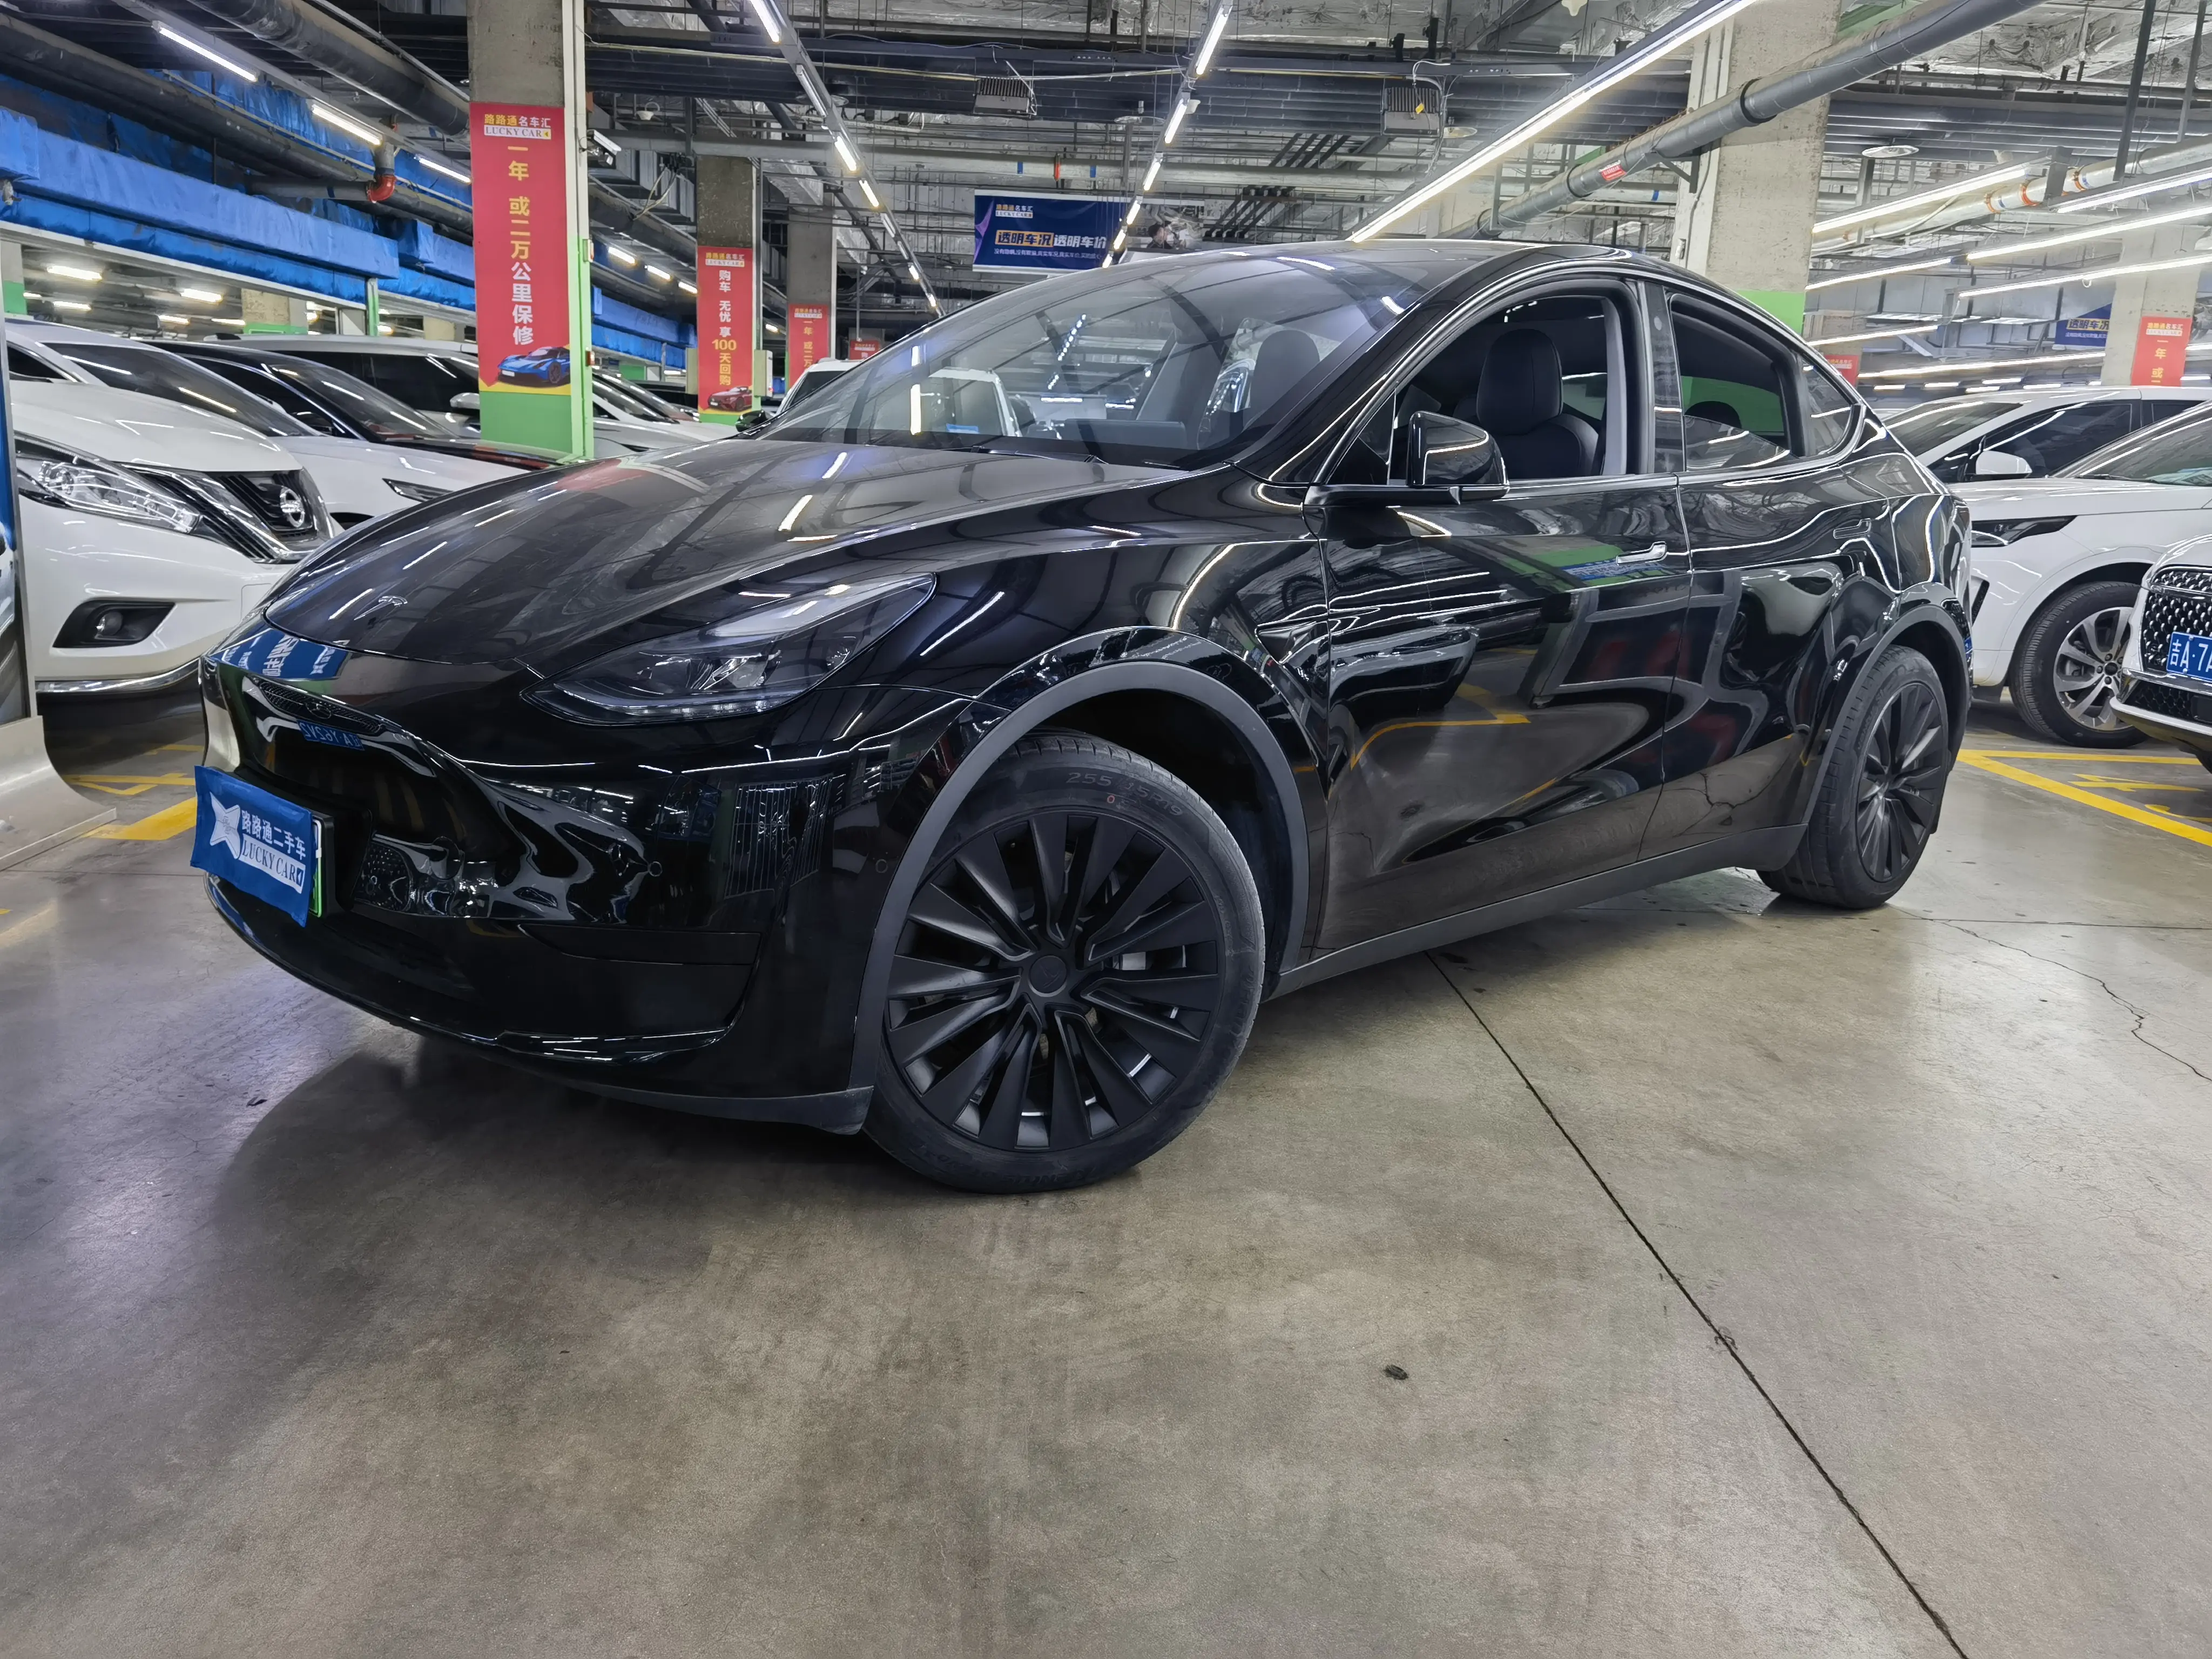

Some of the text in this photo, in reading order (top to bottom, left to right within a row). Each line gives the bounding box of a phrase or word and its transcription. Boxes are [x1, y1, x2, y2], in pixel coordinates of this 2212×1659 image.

[484, 114, 551, 128] 路路通名车汇
[485, 126, 542, 137] LUCKY CAR
[997, 232, 1107, 249] 透明车况 透明车价
[241, 810, 306, 860] 路路通二手车
[241, 838, 295, 883] LUCKY CAR
